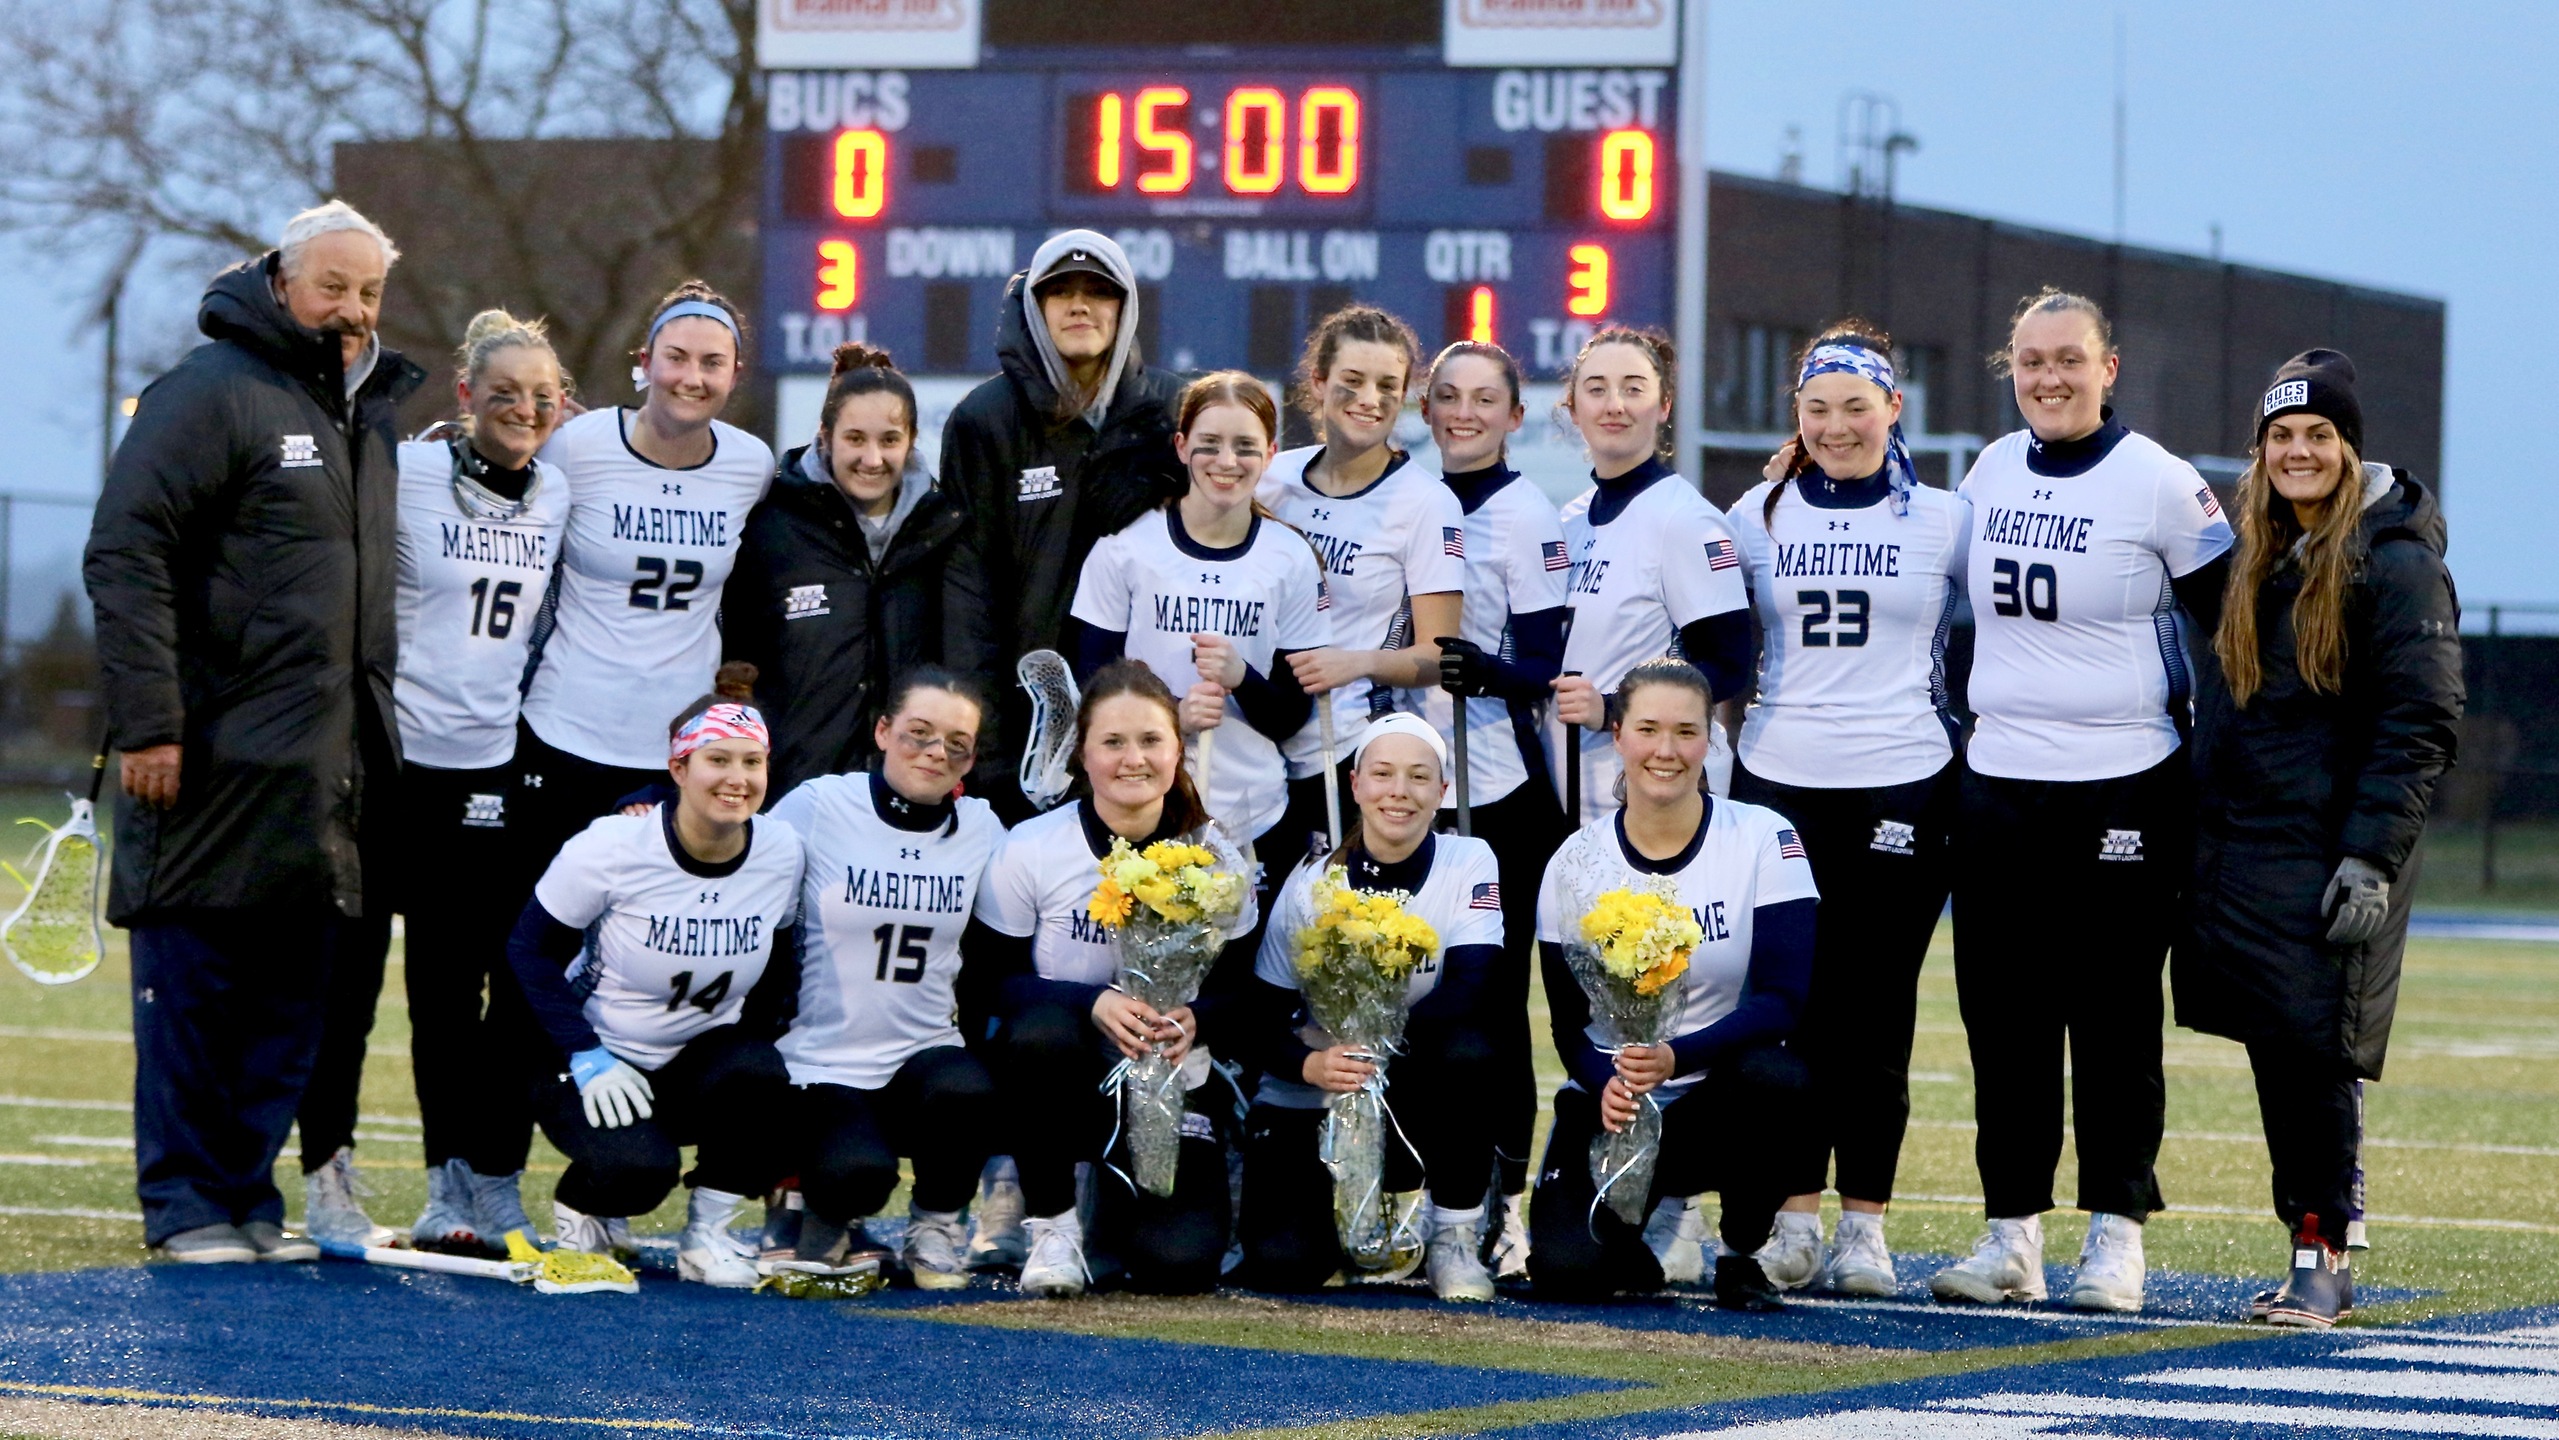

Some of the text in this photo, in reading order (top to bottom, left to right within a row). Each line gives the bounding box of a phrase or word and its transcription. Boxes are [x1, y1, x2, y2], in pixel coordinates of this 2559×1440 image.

[767, 71, 910, 131] BUCS
[1492, 70, 1668, 131] GUEST
[1099, 87, 1359, 193] 15:00
[834, 130, 885, 217] 0
[1601, 130, 1653, 219] 0
[817, 240, 855, 309] 3
[886, 228, 1015, 278] DOWN
[1224, 230, 1379, 281] BALL ON
[1425, 229, 1513, 282] QTR
[1568, 244, 1608, 314] 3
[1471, 286, 1493, 343] 1
[2266, 395, 2304, 413] LACROSSE
[2267, 383, 2304, 405] BUCS
[441, 523, 546, 571] MARITIME
[613, 503, 727, 547] MARITIME
[1983, 507, 2094, 554] MARITIME
[629, 556, 704, 611] 22
[1775, 543, 1901, 578] MARITIME
[470, 577, 523, 639] 16
[1155, 594, 1265, 636] MARITIME
[1992, 557, 2058, 622] 30
[1796, 589, 1871, 648] 23
[844, 865, 965, 913] MARITIME
[644, 915, 763, 957] MARITIME
[873, 923, 935, 984] 15
[666, 970, 734, 1015] 14
